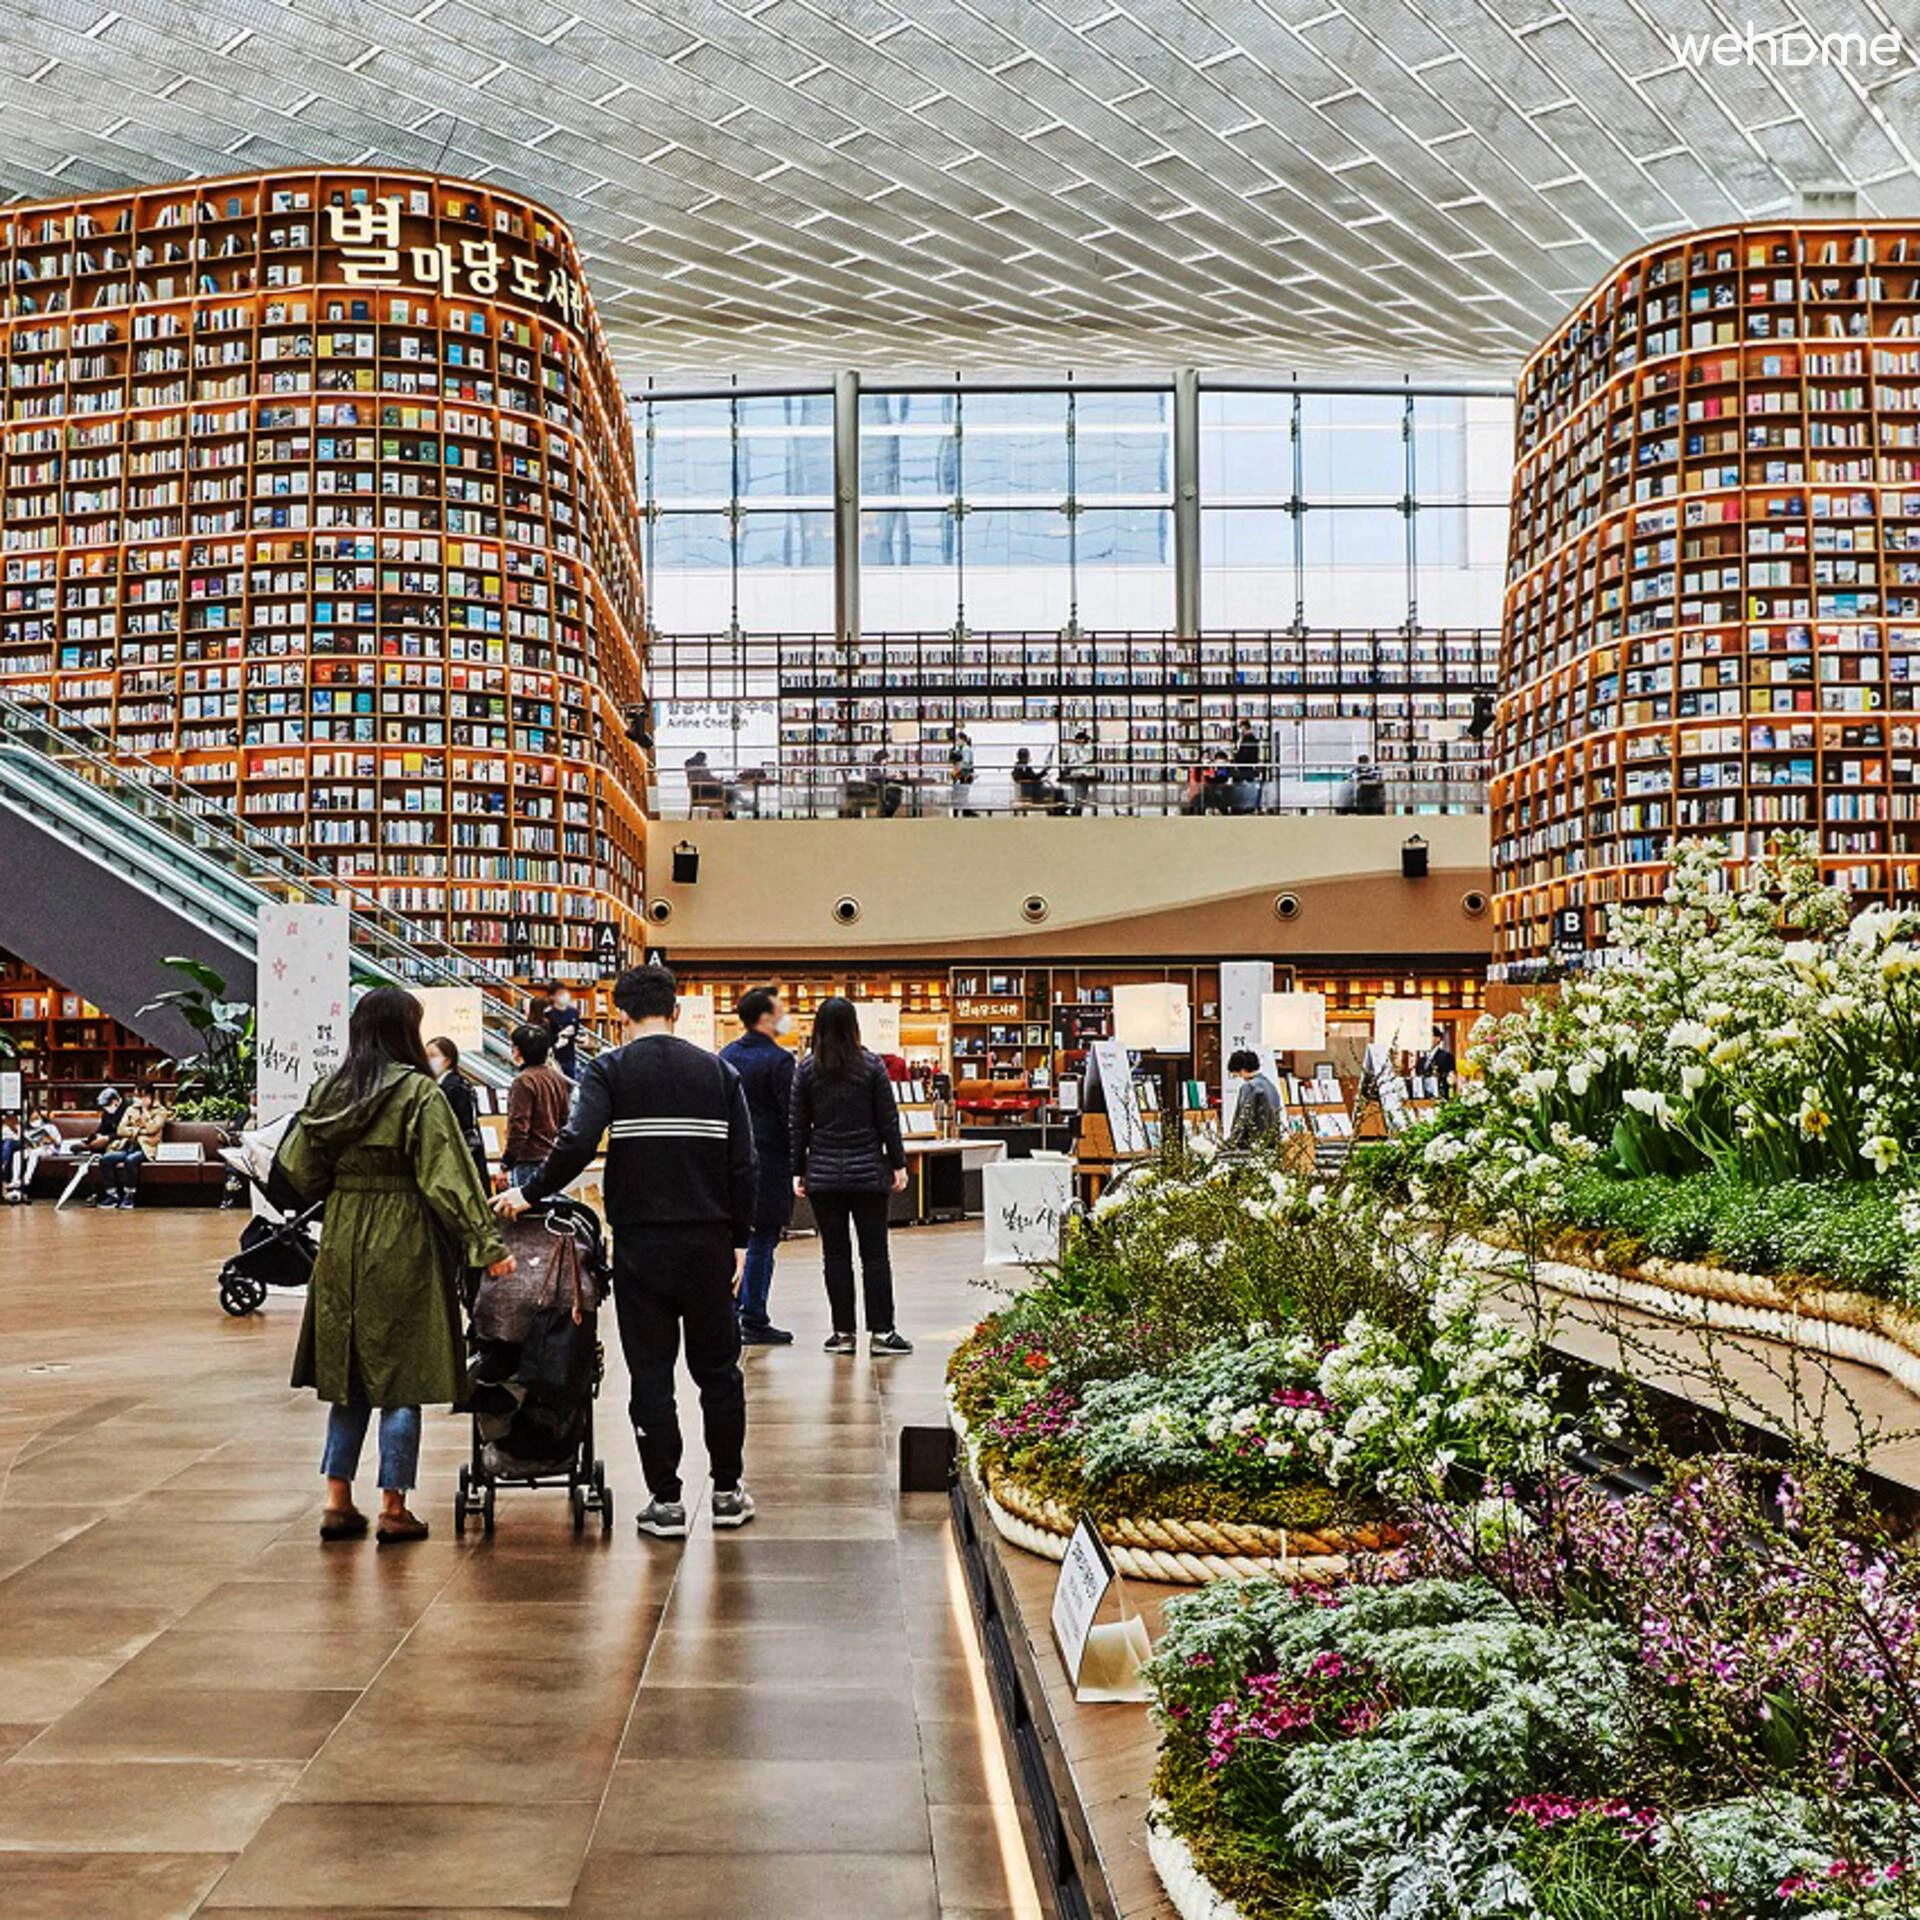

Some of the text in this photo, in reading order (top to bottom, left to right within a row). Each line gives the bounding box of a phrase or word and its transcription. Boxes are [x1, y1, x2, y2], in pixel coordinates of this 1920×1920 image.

[515, 920, 528, 941] A
[1563, 911, 1580, 932] B
[601, 927, 616, 946] A
[648, 951, 661, 967] A
